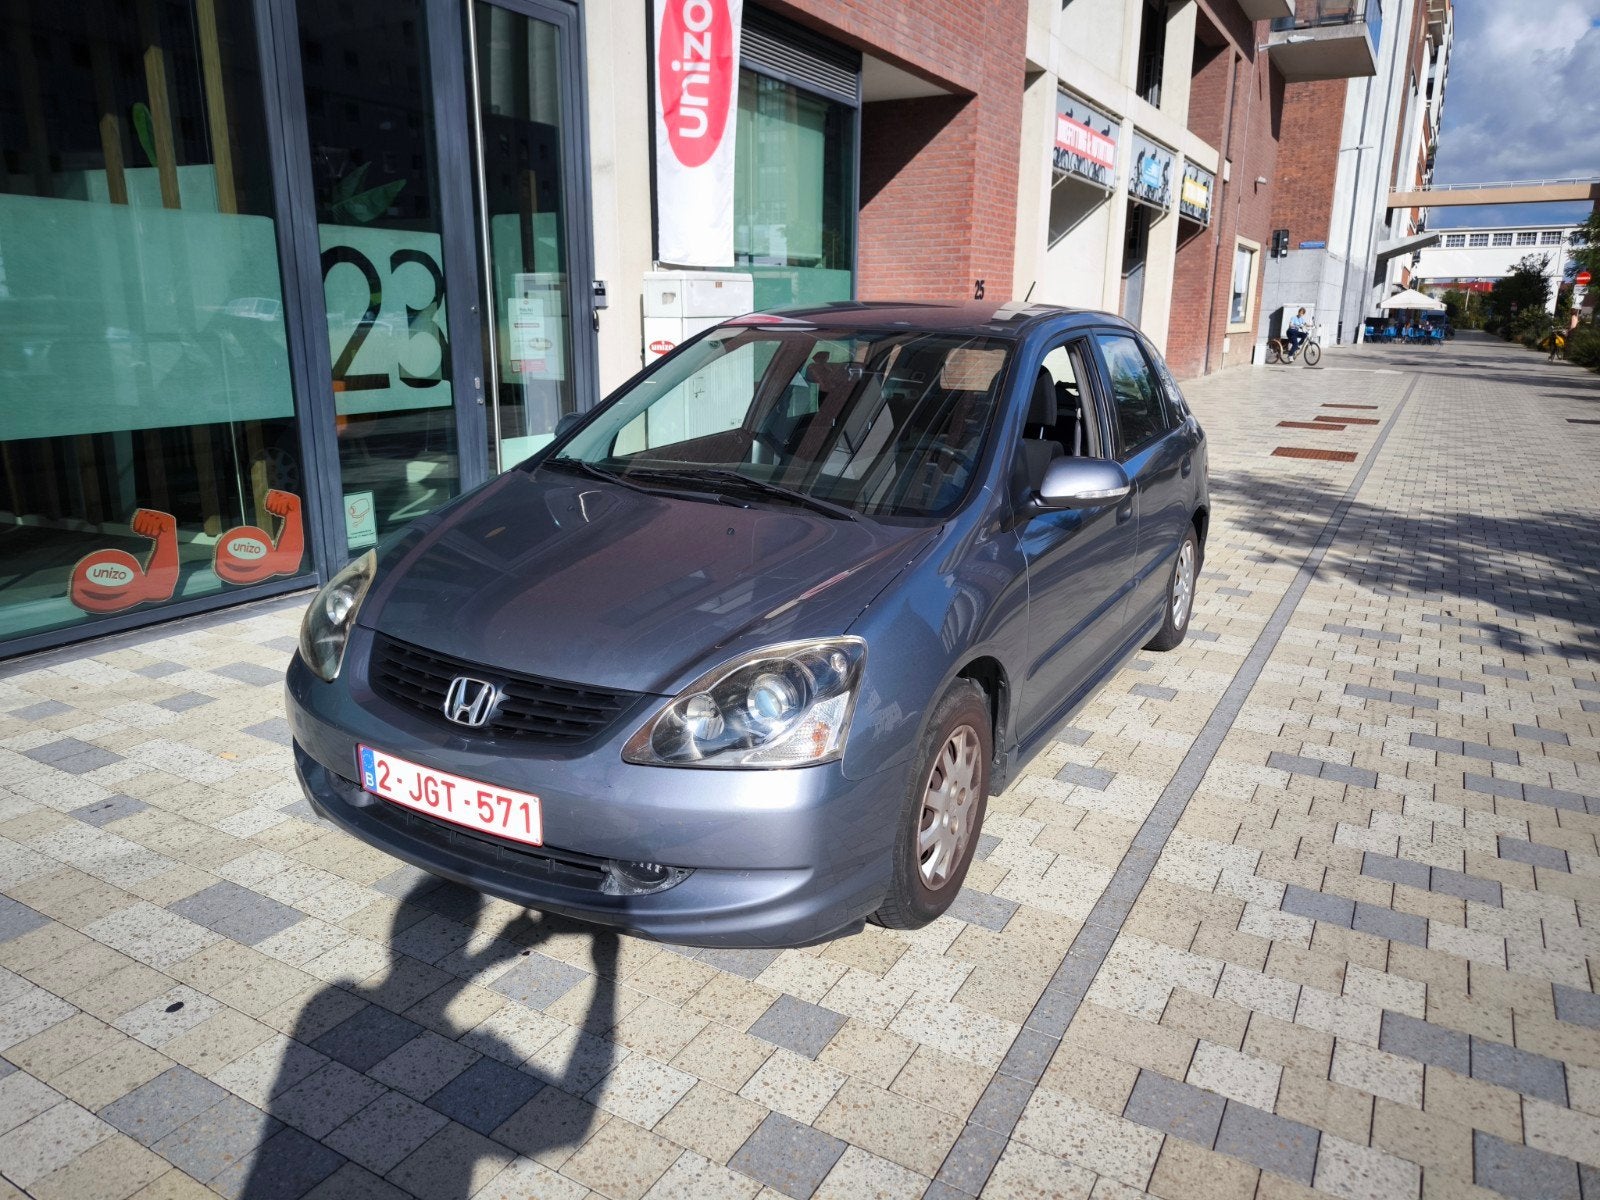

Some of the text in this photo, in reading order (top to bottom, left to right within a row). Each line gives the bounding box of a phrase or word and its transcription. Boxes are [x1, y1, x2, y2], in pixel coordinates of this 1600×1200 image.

[671, 0, 713, 138] unizo
[974, 279, 985, 300] 25
[321, 245, 451, 392] 23
[651, 341, 675, 351] unizo
[233, 542, 261, 555] unizo
[92, 567, 127, 581] unizo
[365, 759, 532, 834] B 2-JGT-571
